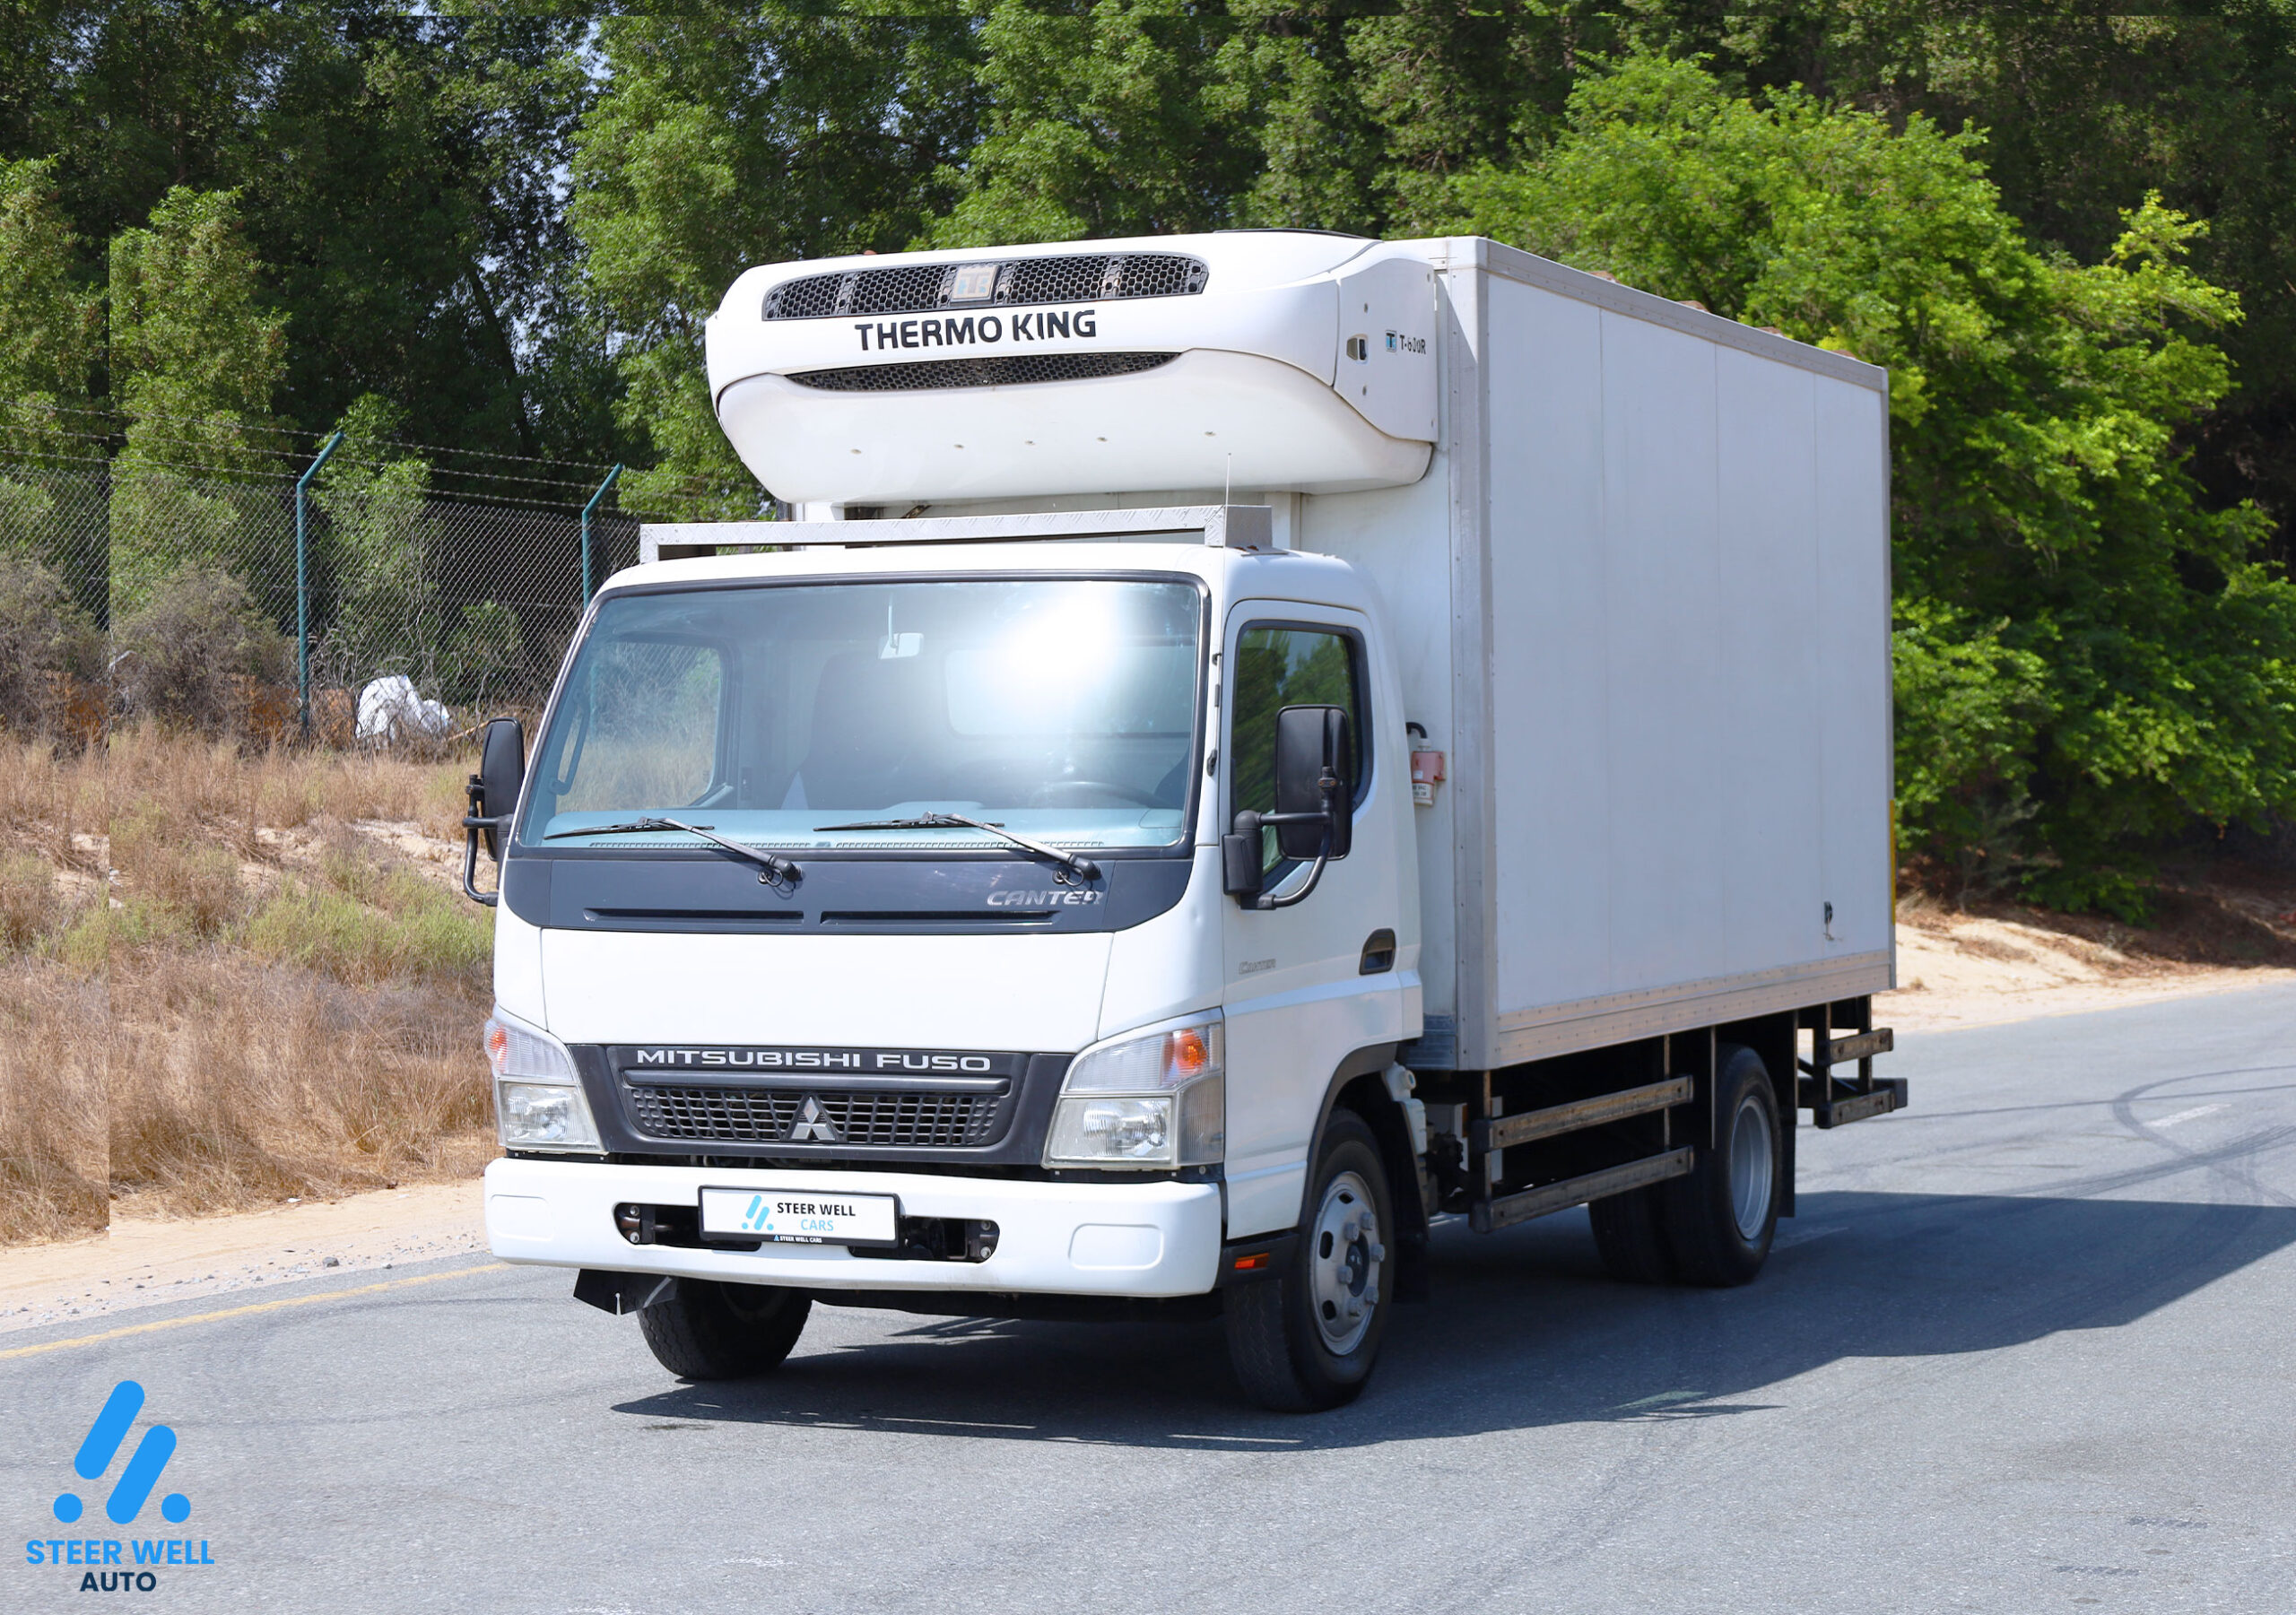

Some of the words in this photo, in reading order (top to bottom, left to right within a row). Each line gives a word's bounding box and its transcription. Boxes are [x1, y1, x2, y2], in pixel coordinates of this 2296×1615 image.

[855, 316, 1003, 351] THERMO
[1012, 309, 1097, 342] KING
[987, 890, 1104, 907] CANTER
[637, 1049, 861, 1068] MITSUBISHI
[876, 1054, 991, 1072] FUSO
[777, 1203, 816, 1215] STEER
[819, 1203, 857, 1217] WELL
[800, 1219, 834, 1231] CARS
